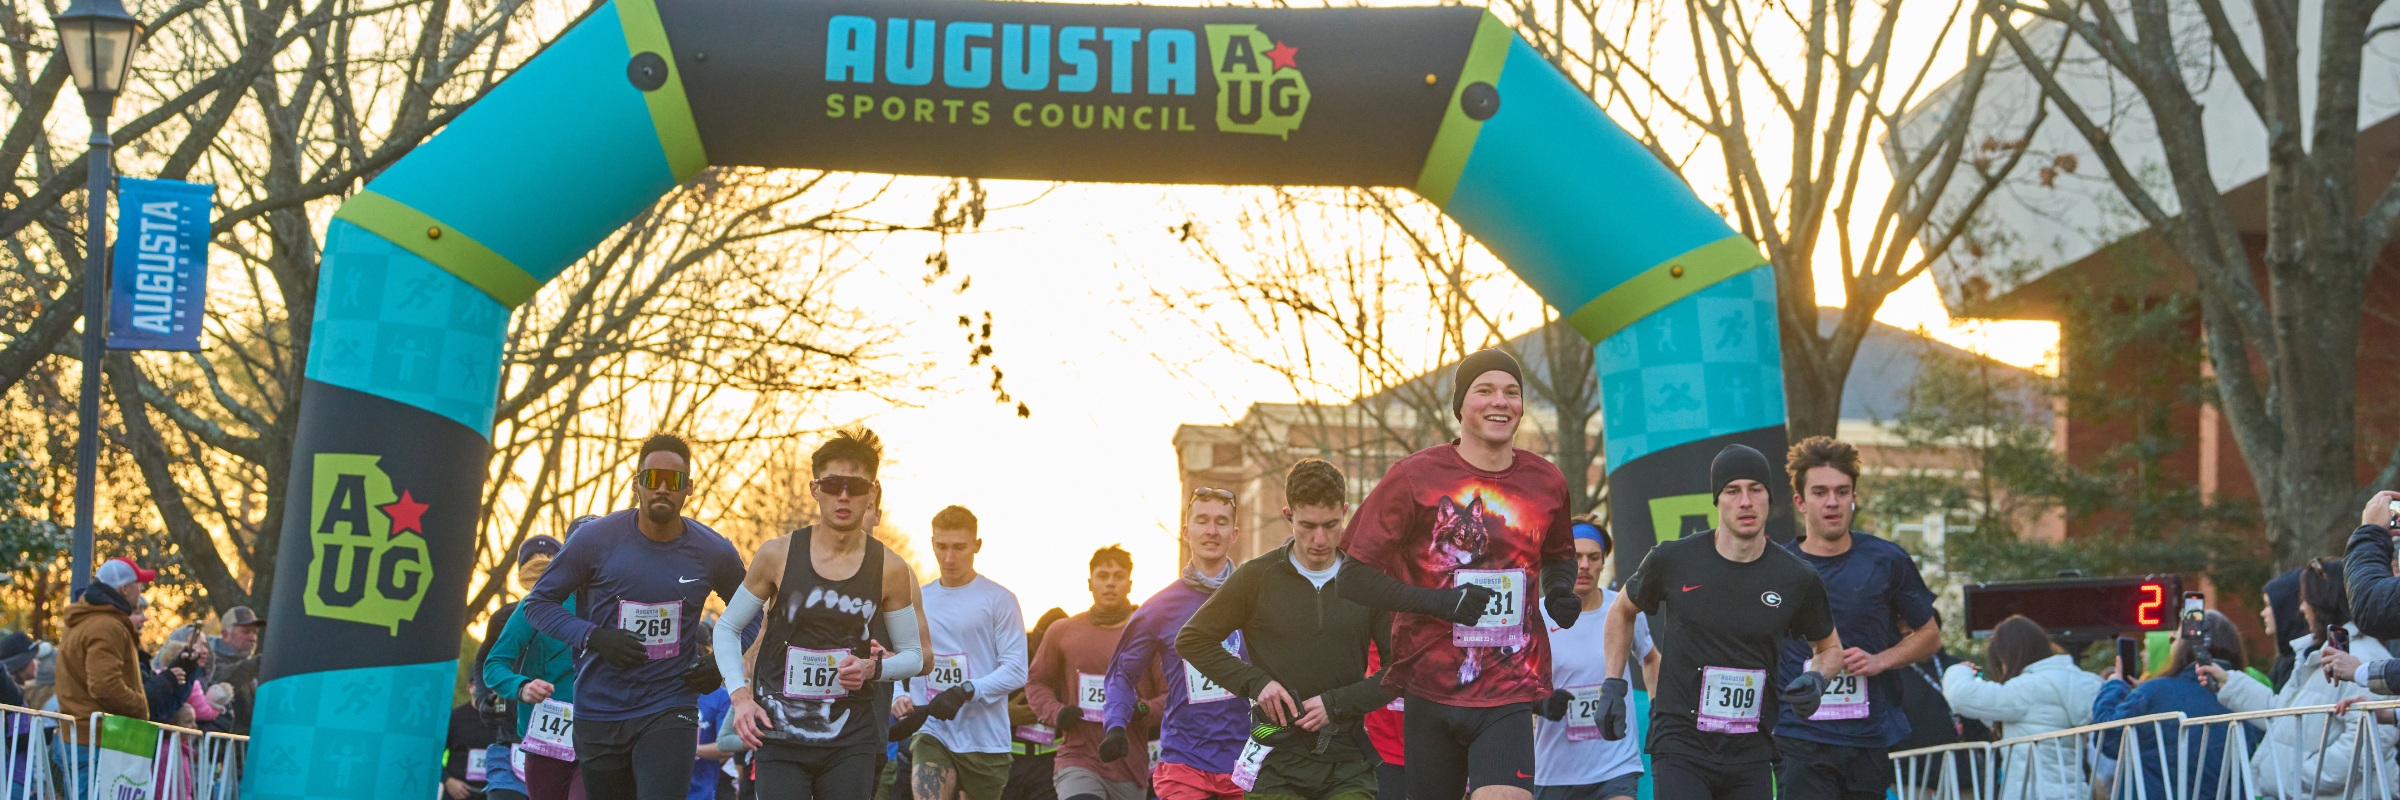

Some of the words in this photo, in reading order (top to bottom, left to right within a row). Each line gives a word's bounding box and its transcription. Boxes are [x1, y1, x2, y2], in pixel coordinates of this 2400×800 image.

[825, 14, 1197, 95] AUGUSTA
[826, 93, 991, 125] SPORTS
[1013, 102, 1196, 131] COUNCIL
[132, 201, 179, 334] AUGUSTA
[173, 206, 191, 332] UNIVERSITY
[1483, 591, 1514, 615] 31
[2138, 585, 2161, 624] 2
[635, 618, 671, 637] 269
[802, 667, 839, 687] 167
[934, 667, 962, 683] 249
[1823, 675, 1857, 694] 29
[1719, 686, 1755, 708] 309
[539, 714, 573, 736] 147
